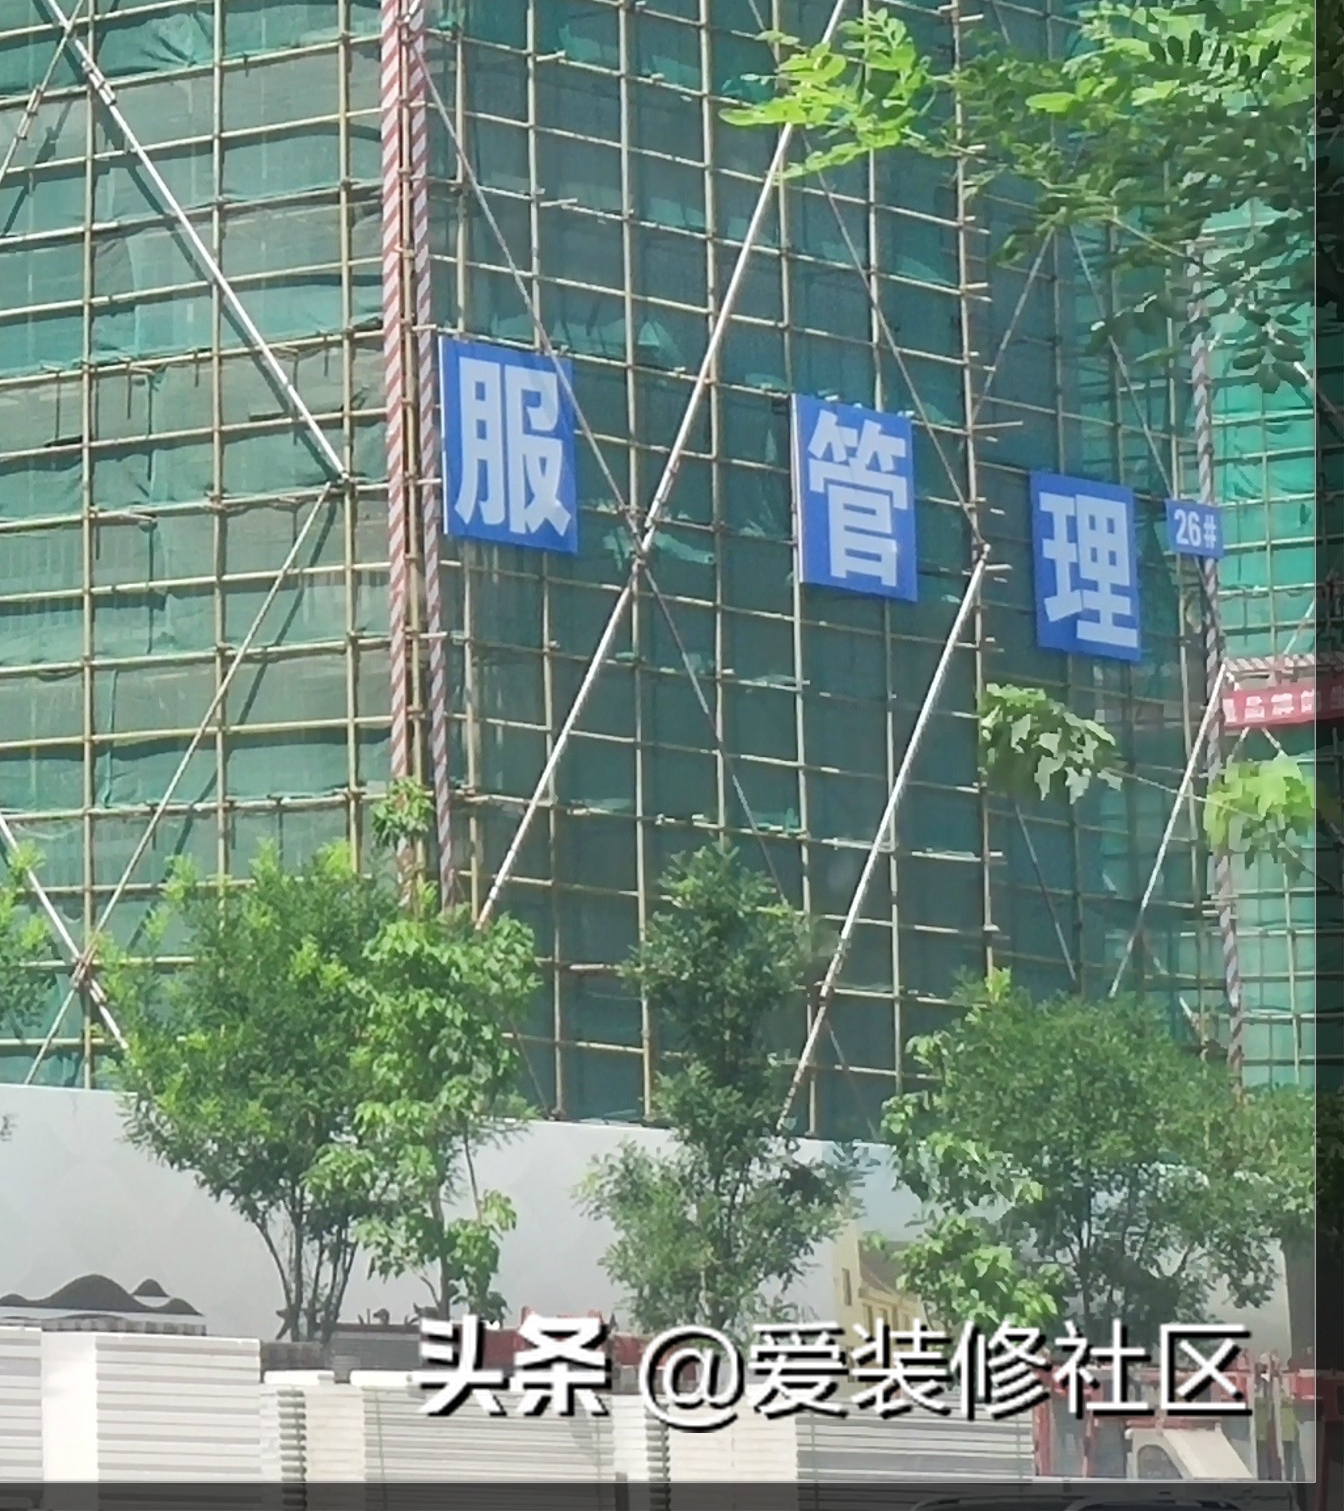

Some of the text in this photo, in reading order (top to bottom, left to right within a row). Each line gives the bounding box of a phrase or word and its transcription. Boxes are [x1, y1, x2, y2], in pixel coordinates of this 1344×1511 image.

[454, 355, 1138, 649] 服 管 理
[1173, 508, 1217, 550] 26#
